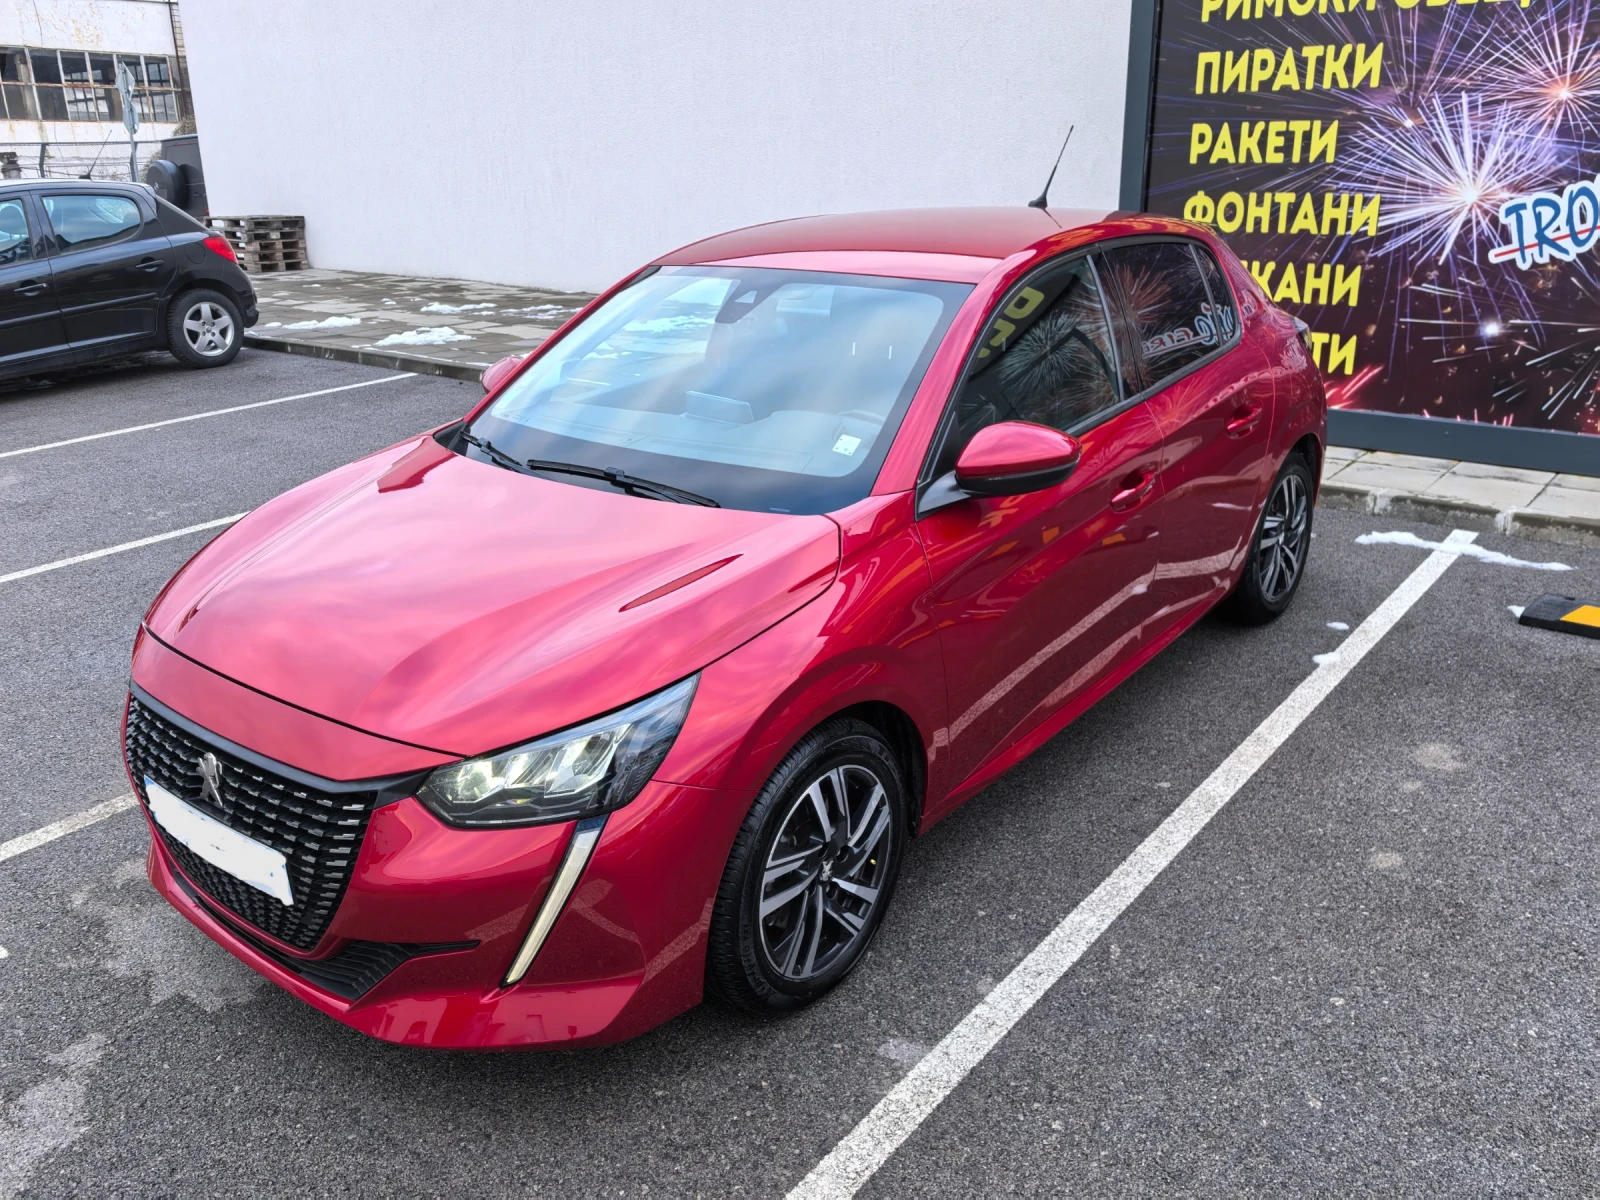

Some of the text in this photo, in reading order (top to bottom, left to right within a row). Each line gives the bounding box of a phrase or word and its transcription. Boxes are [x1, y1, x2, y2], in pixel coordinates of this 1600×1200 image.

[1195, 42, 1384, 94] ПИРАТКИ
[1189, 120, 1339, 164] РАКЕТИ
[1184, 191, 1381, 236] ФОНТАНИ
[1497, 180, 1600, 267] TRO
[1243, 261, 1361, 307] КАНИ
